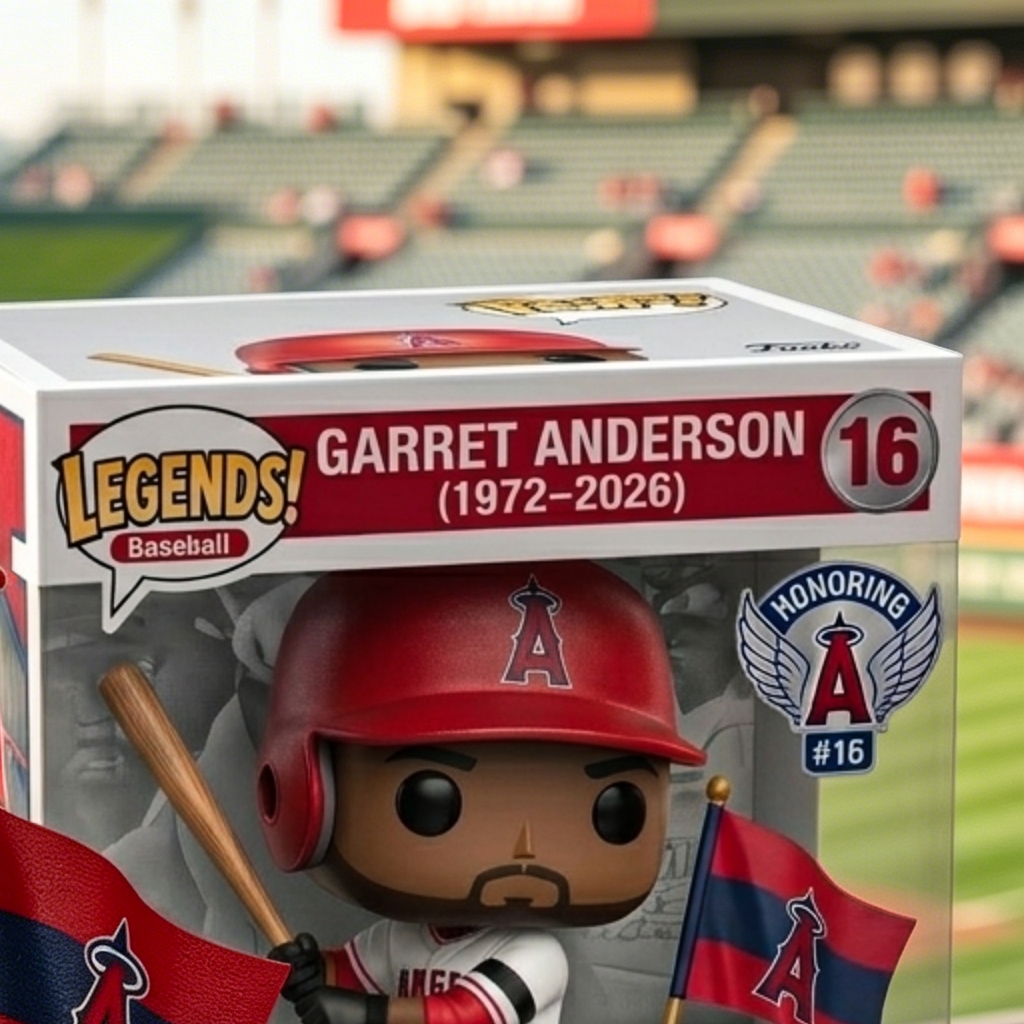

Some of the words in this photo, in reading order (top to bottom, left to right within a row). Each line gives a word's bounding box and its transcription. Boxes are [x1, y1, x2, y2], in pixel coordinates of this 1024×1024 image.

[316, 421, 518, 476] GARRET
[533, 410, 805, 467] ANDERSON
[839, 416, 919, 487] 16
[52, 447, 307, 548] LEGENDS!
[128, 532, 229, 558] Baseball
[769, 570, 910, 622] HONORING
[802, 611, 875, 726] A
[812, 738, 865, 766] #16
